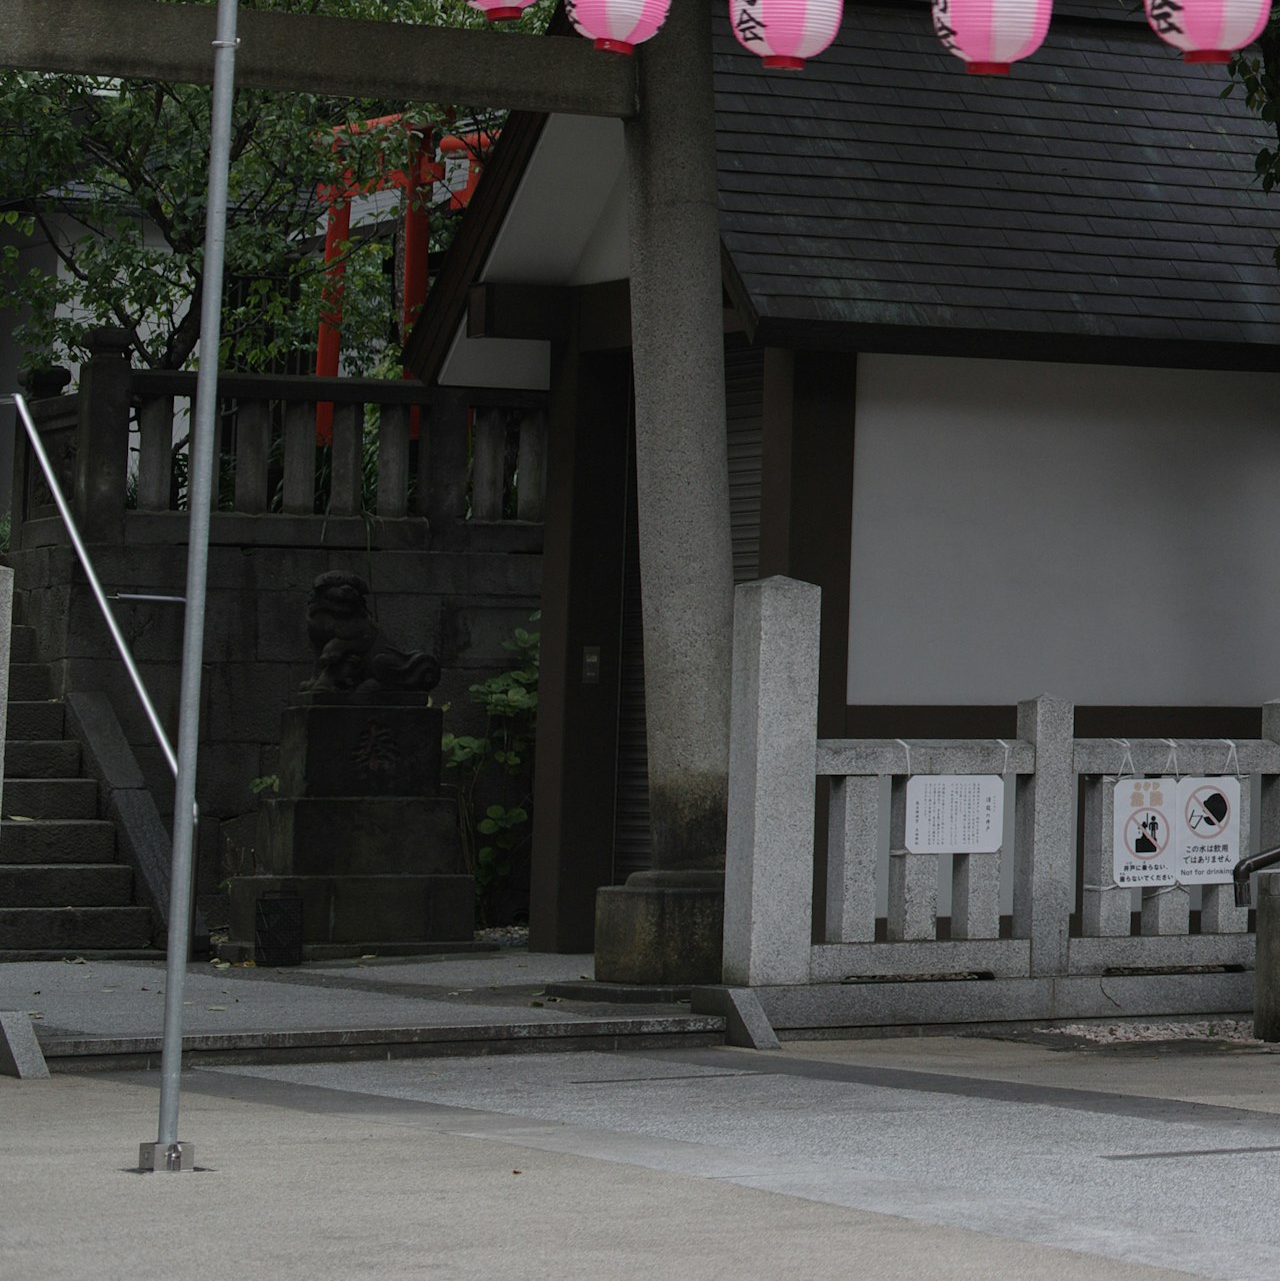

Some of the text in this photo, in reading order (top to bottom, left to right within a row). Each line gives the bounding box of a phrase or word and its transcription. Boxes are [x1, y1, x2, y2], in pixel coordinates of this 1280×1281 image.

[1186, 844, 1228, 853] この水は飲用
[1183, 855, 1231, 864] ではありません
